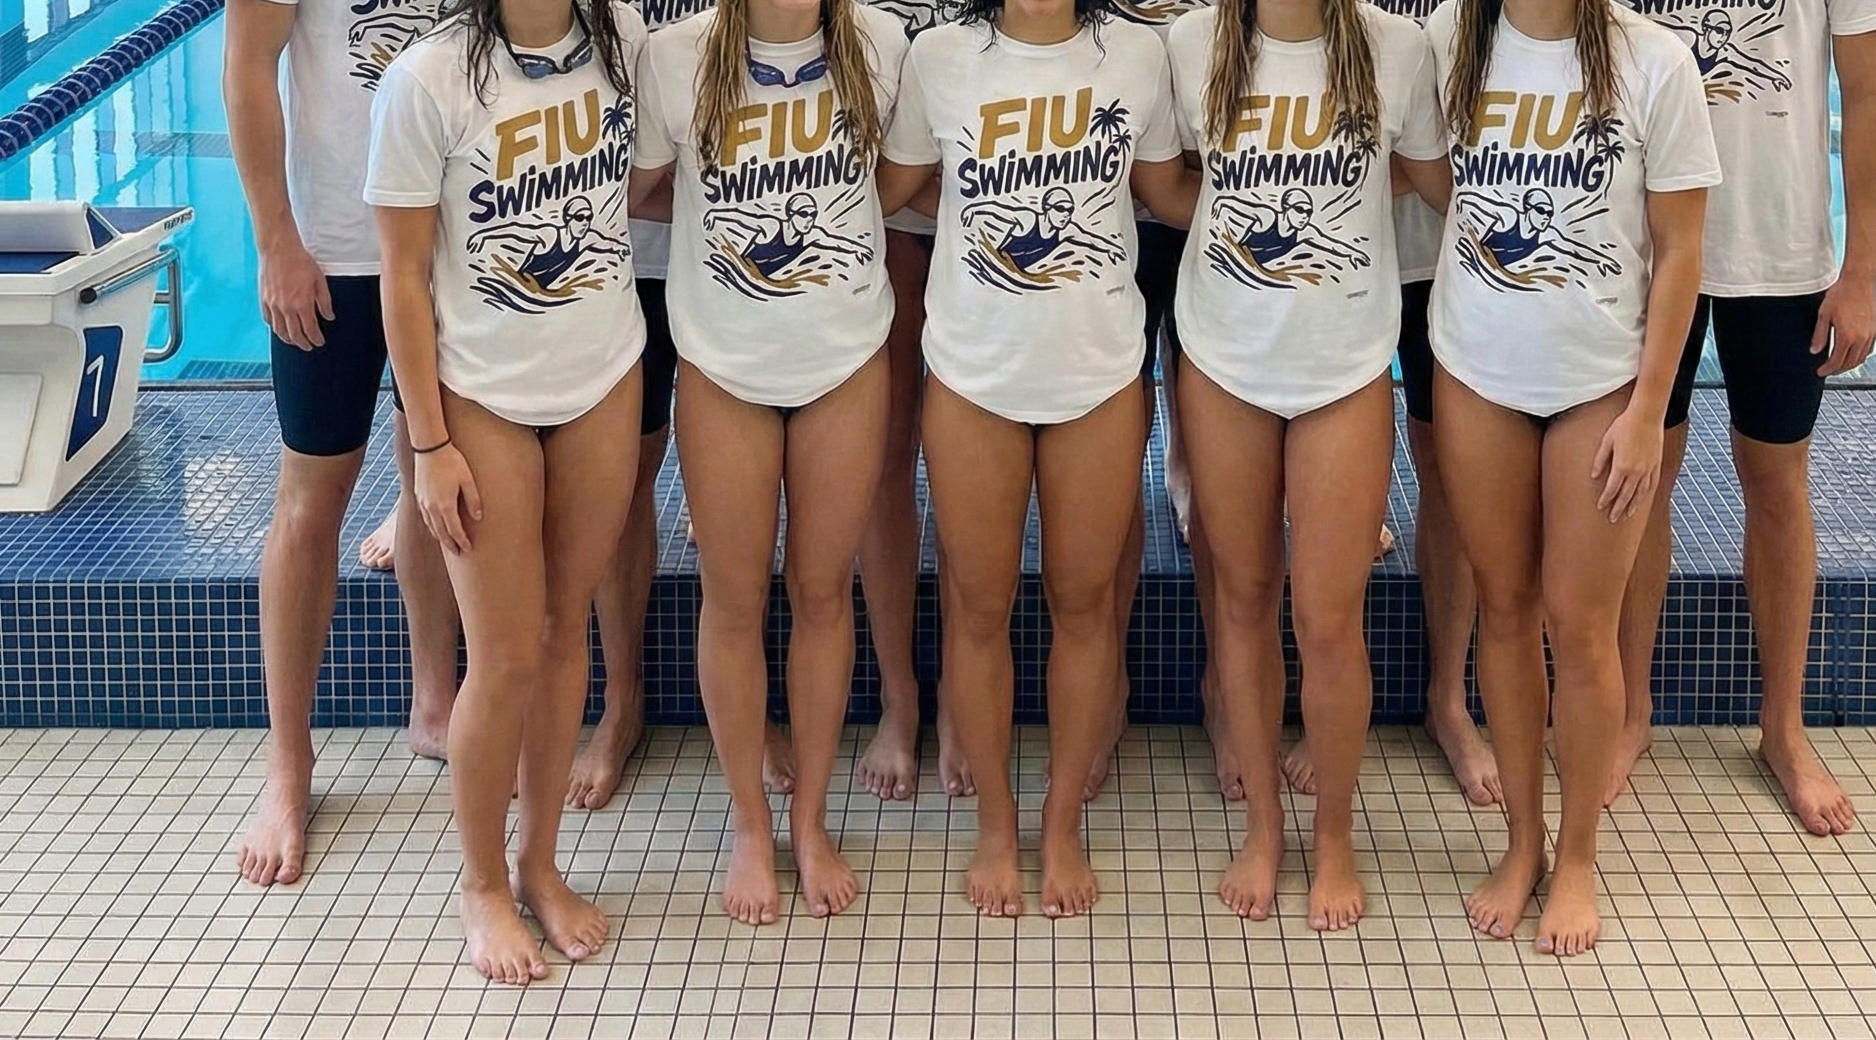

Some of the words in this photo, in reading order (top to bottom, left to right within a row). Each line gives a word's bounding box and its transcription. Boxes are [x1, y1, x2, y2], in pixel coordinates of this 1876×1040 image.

[495, 88, 601, 181] FIU
[720, 89, 834, 168] FIU
[978, 86, 1093, 160] FIU
[1221, 91, 1338, 153] FIU
[1465, 91, 1584, 150] FIU
[86, 354, 105, 418] 1
